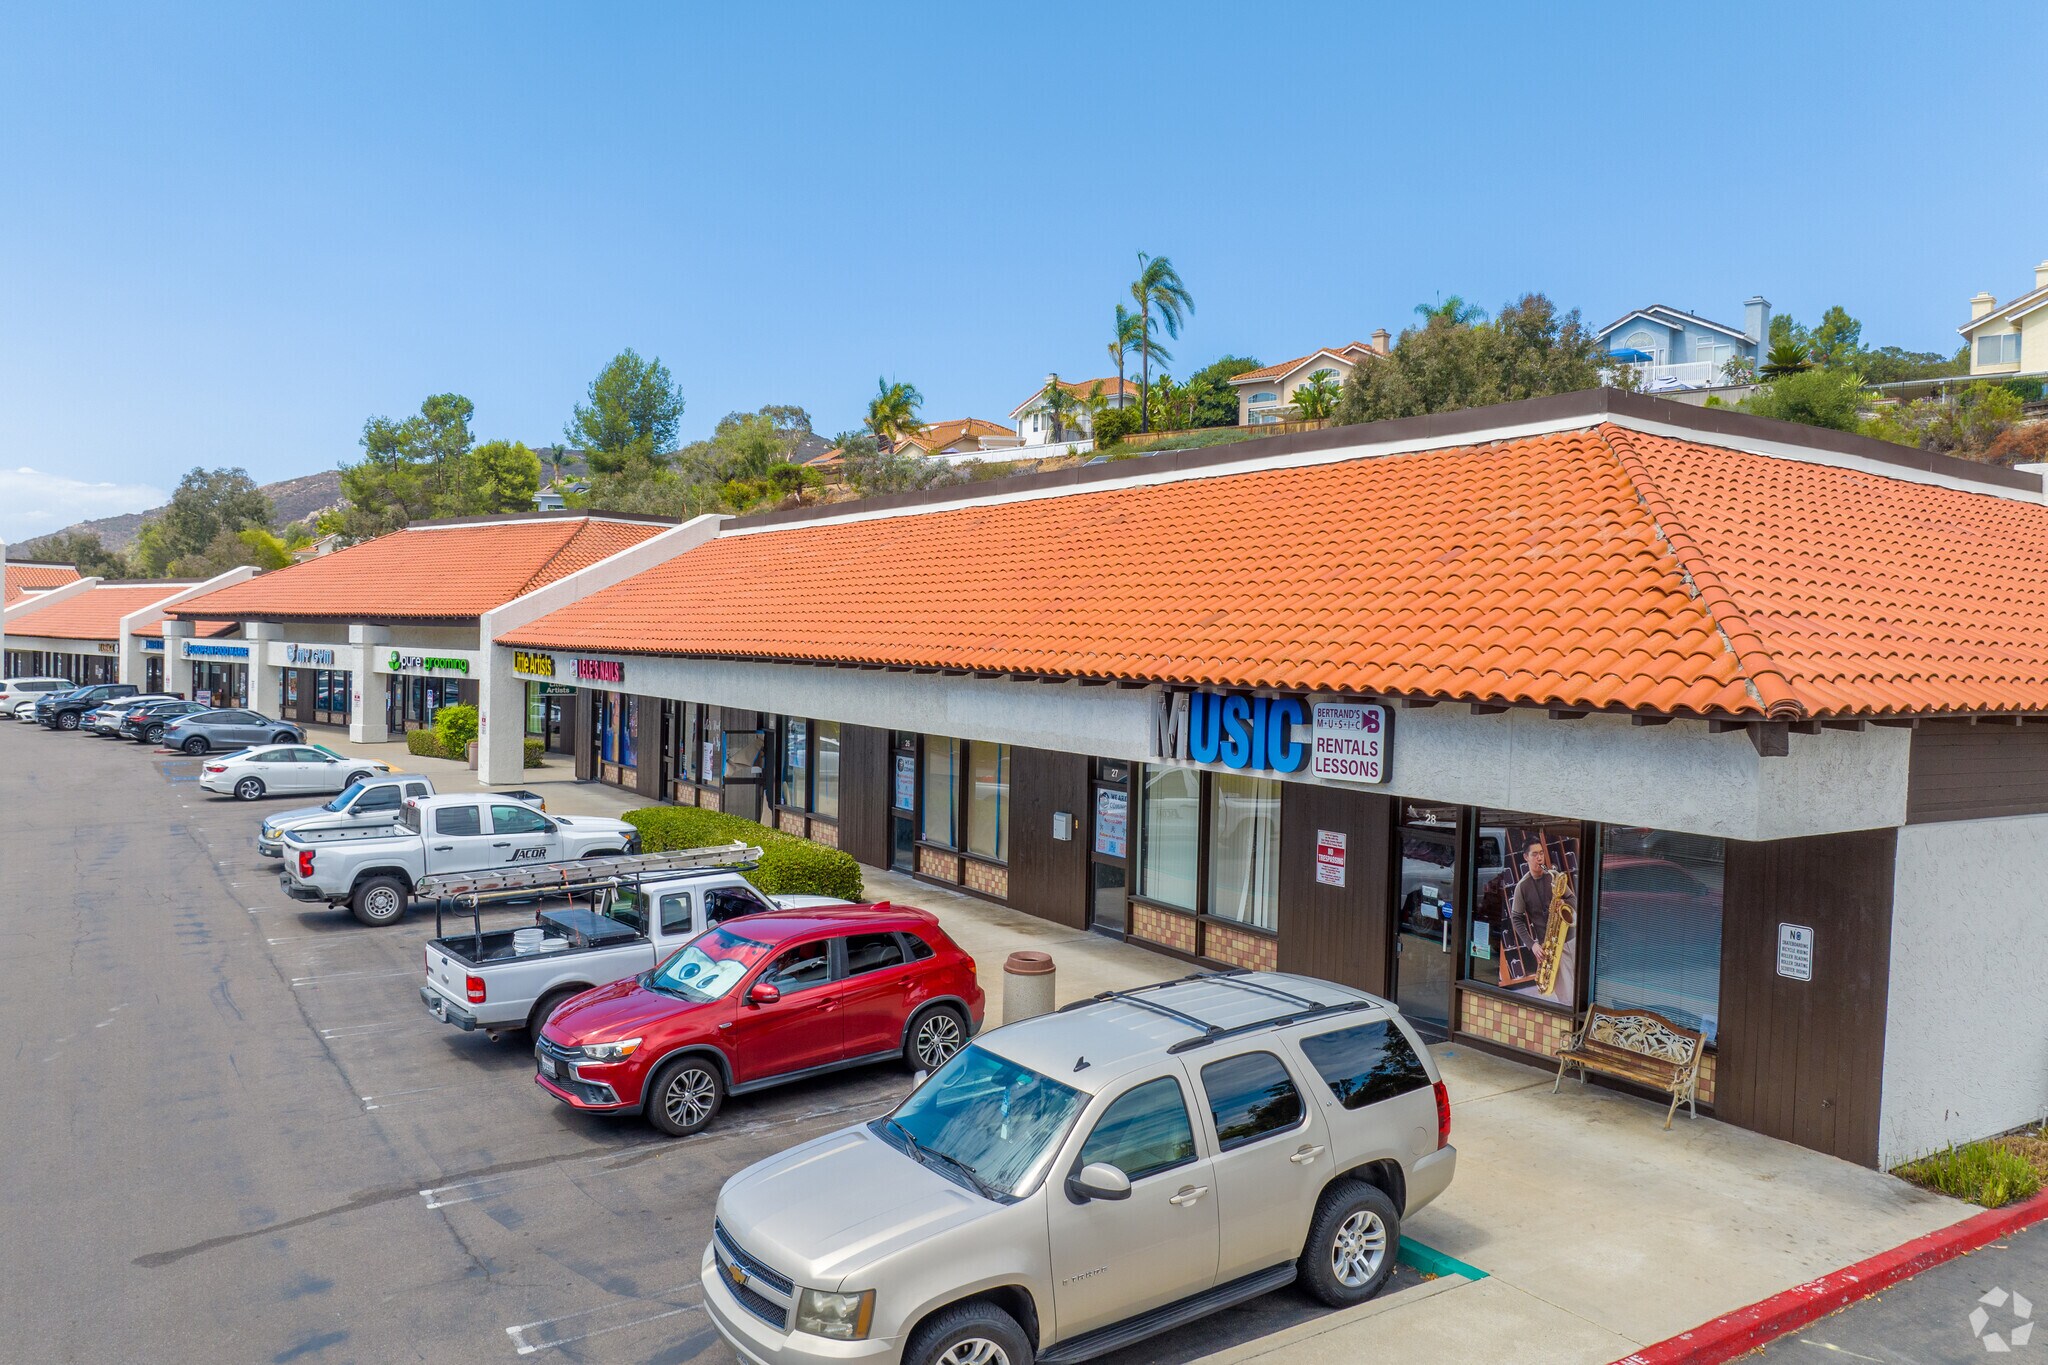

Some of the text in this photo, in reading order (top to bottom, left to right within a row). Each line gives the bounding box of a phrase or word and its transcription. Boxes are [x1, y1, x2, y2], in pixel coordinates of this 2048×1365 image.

[188, 644, 249, 657] EUROPEAN FOOD MARKE
[296, 649, 333, 664] MY GYM
[401, 656, 467, 673] pure grooming
[513, 651, 552, 676] Little Artists
[578, 659, 620, 682] LELE'S NAILS
[1317, 707, 1360, 719] BERTRAND'S
[1149, 690, 1304, 773] MUSIC
[1316, 737, 1379, 757] RENTALS
[1111, 769, 1119, 778] 27
[1315, 756, 1379, 778] LESSONS
[1425, 813, 1437, 825] 28
[505, 847, 547, 862] JACOR
[1790, 930, 1801, 940] NO
